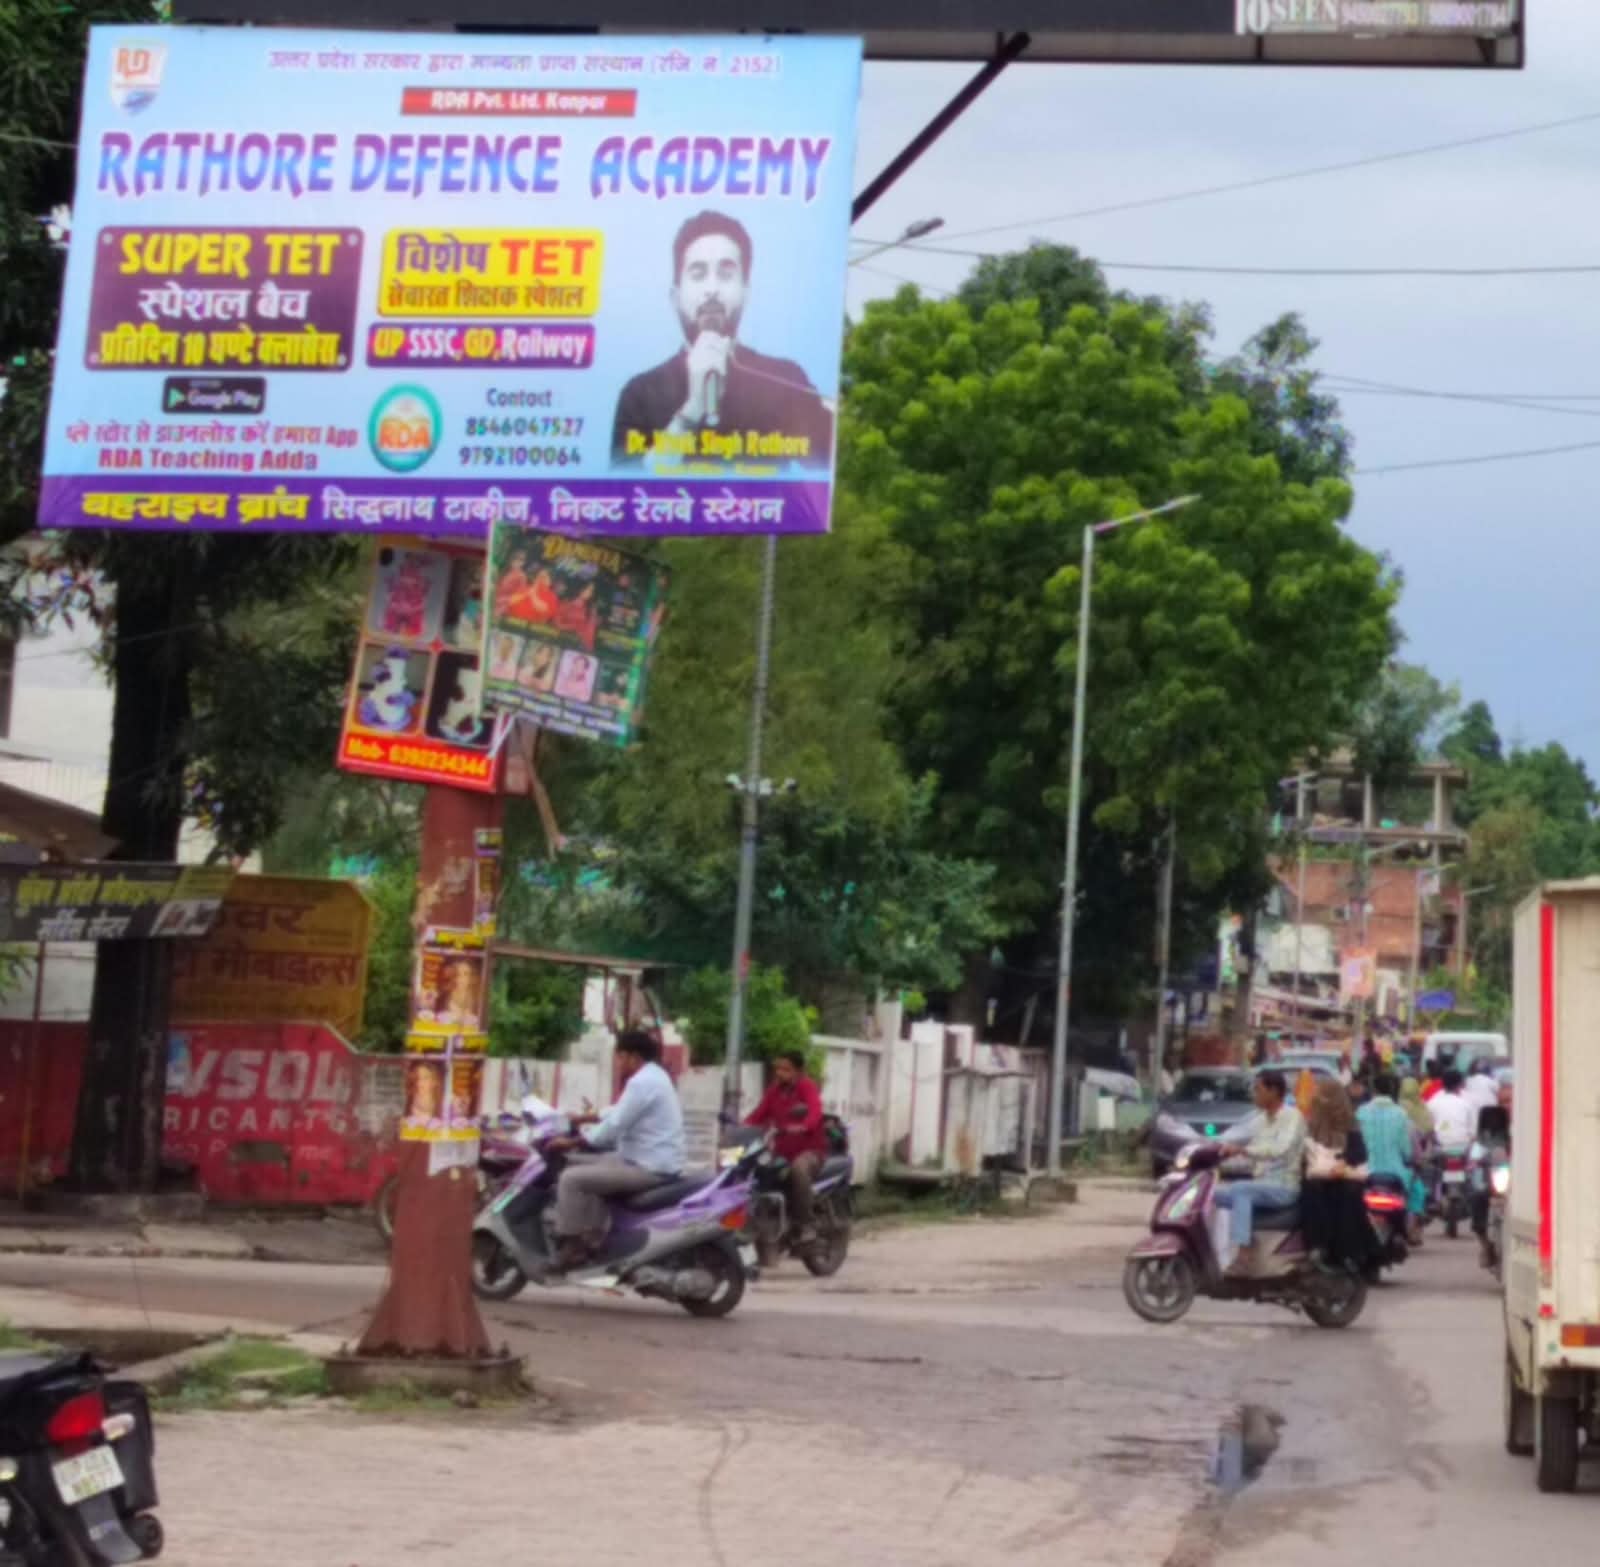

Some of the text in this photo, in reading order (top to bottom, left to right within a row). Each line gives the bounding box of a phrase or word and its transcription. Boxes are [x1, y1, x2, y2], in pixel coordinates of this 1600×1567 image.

[98, 132, 830, 202] RATHORE DEFENCE ACADEMY
[119, 232, 341, 278] SUPER TET
[396, 233, 595, 276] विशेष TET
[138, 280, 310, 319] स्पेशल बैच
[100, 322, 179, 364] प्रतिदिन
[373, 327, 405, 358] UP
[486, 388, 553, 408] Contact
[325, 426, 358, 447] App
[98, 448, 319, 472] RDA Teaching Adda
[82, 492, 231, 522] बहराइच
[322, 485, 436, 524] सिद्धनाथ
[550, 486, 625, 523] निकट
[631, 486, 694, 524] रेलवे
[702, 487, 786, 524] स्टेशन
